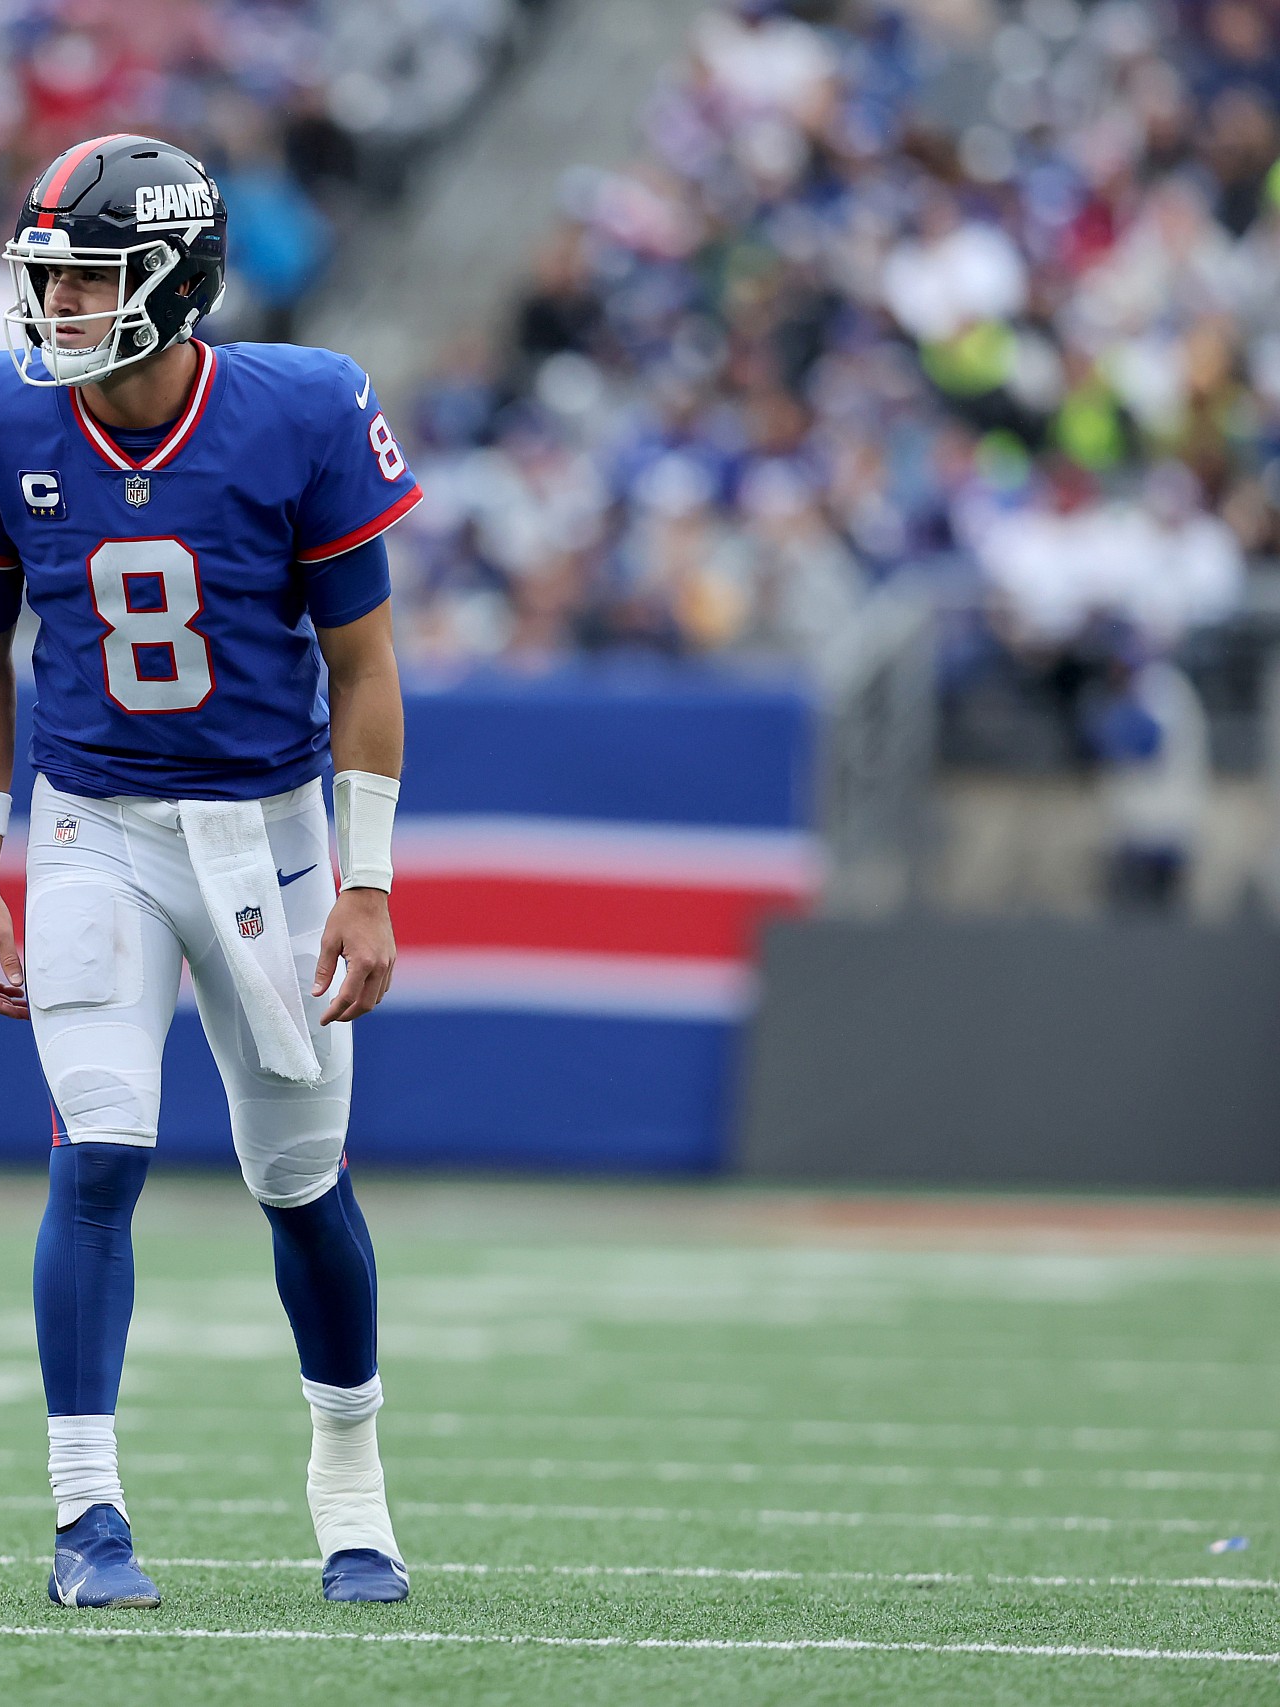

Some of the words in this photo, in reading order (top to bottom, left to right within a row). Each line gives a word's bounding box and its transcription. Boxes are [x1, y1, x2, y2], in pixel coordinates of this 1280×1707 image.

[136, 183, 213, 221] GIANTS
[368, 411, 407, 482] 8
[21, 473, 60, 507] C
[128, 489, 147, 501] NFL
[86, 535, 216, 715] 8
[56, 828, 73, 840] NFL
[240, 919, 262, 936] NFL
